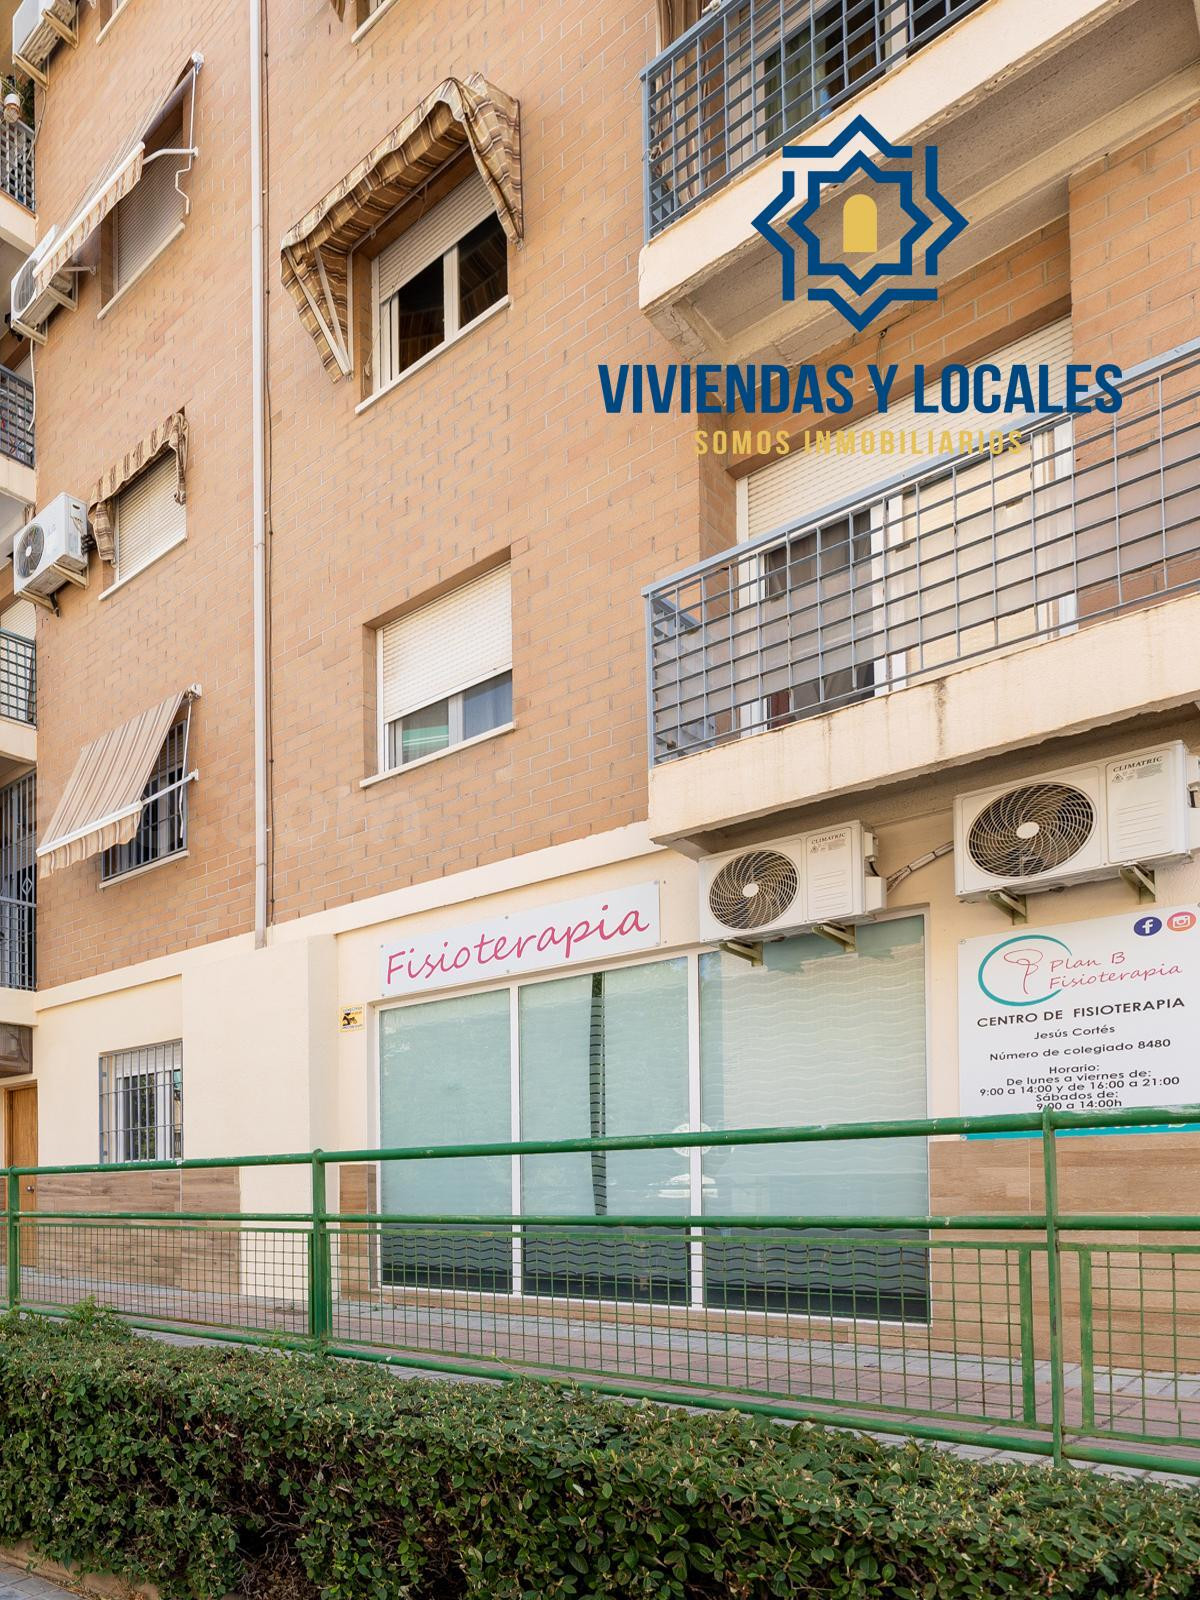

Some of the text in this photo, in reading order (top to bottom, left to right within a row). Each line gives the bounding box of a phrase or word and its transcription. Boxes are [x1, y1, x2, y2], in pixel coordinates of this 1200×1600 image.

[1112, 755, 1163, 773] CLIMATRIC
[386, 904, 650, 985] Fisioterapia
[1050, 951, 1126, 973] Plan B
[1049, 963, 1183, 990] Fisioterapia
[976, 997, 1185, 1028] CENTRO DE FISIOTERAPIA
[1033, 1024, 1116, 1040] Jesús Cortés
[989, 1038, 1171, 1061] Número de colegiado 8480
[1006, 1068, 1152, 1087] De lunes a viernes de:
[1049, 1063, 1100, 1075] Horario:
[979, 1087, 1004, 1097] 9:00
[1020, 1085, 1053, 1094] 14:00
[1056, 1085, 1064, 1094] y
[1067, 1082, 1085, 1092] de
[1090, 1080, 1125, 1091] 16:00
[1128, 1080, 1138, 1088] a
[1142, 1076, 1180, 1088] 21:00
[1036, 1090, 1119, 1102] Sábados de:
[1079, 1100, 1122, 1109] 14:00h
